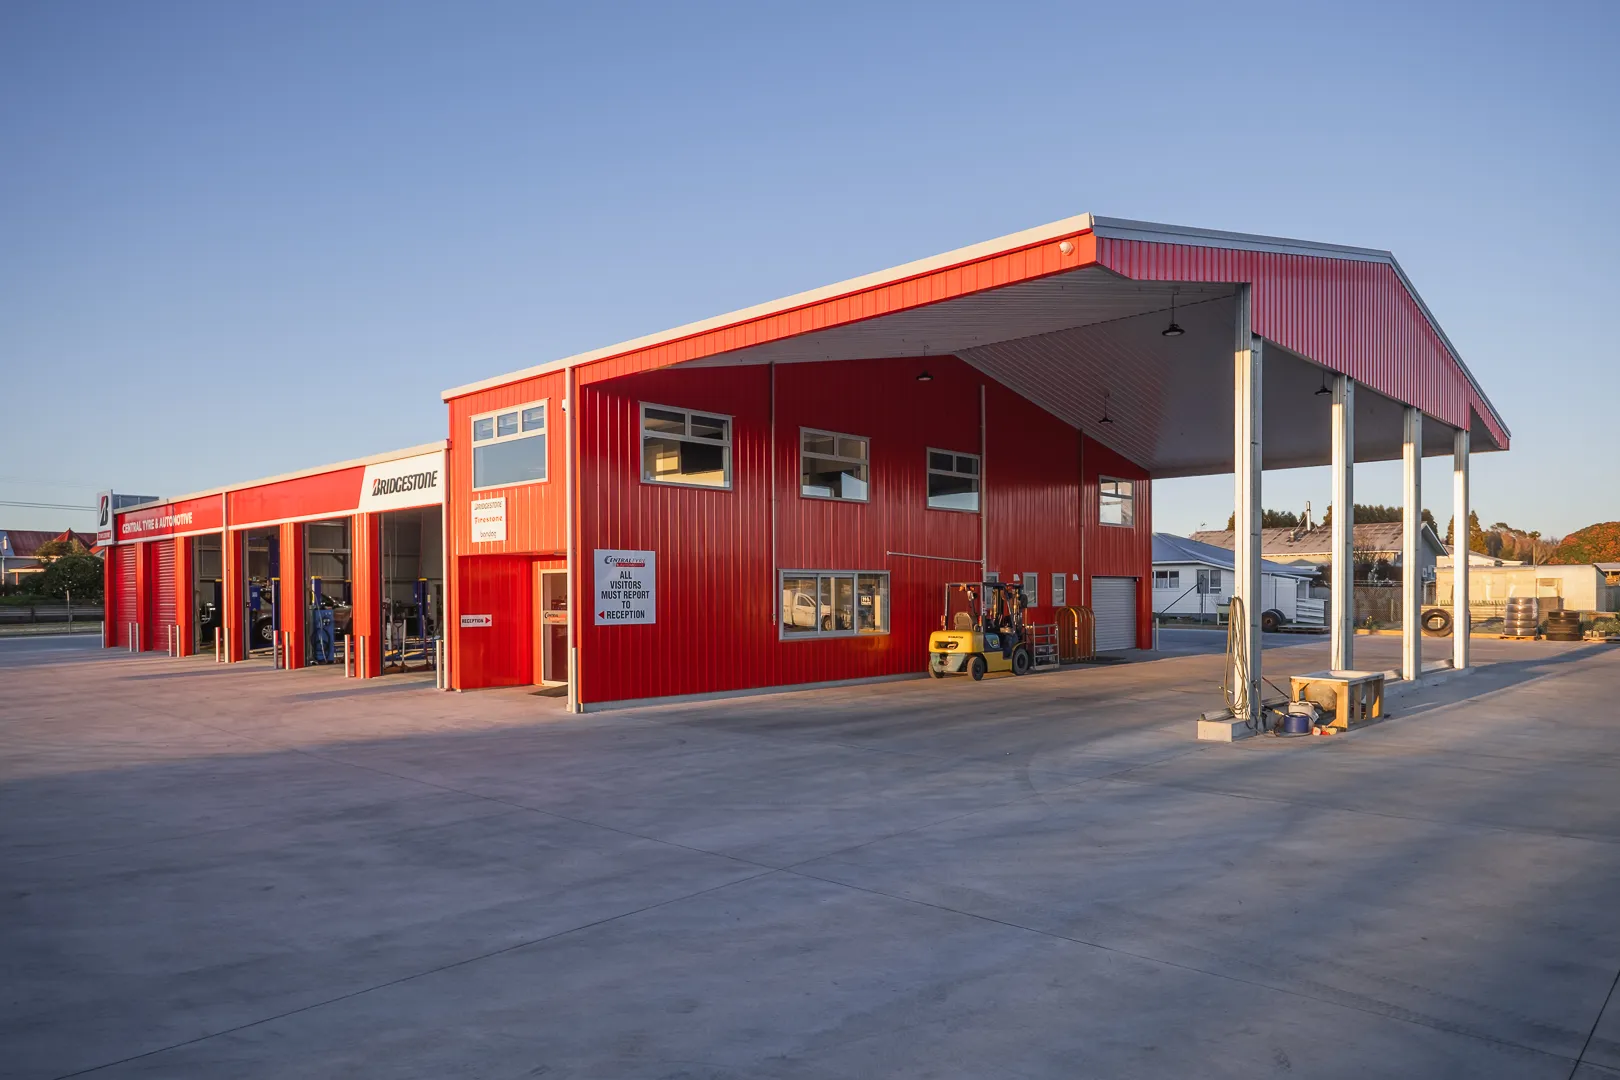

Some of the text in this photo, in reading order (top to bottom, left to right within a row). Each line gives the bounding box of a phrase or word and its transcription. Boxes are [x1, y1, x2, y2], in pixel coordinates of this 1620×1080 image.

[372, 470, 438, 496] BRIDGESTONE
[122, 521, 142, 534] CENTRAL
[142, 518, 155, 531] TYRE
[159, 511, 193, 529] AUTOMOTIVE
[474, 516, 502, 524] Firestone
[620, 571, 632, 579] ALL
[610, 581, 642, 589] VISITORS
[601, 591, 650, 599] MUST REPORT
[622, 601, 631, 609] TO
[606, 610, 645, 619] RECEPTION
